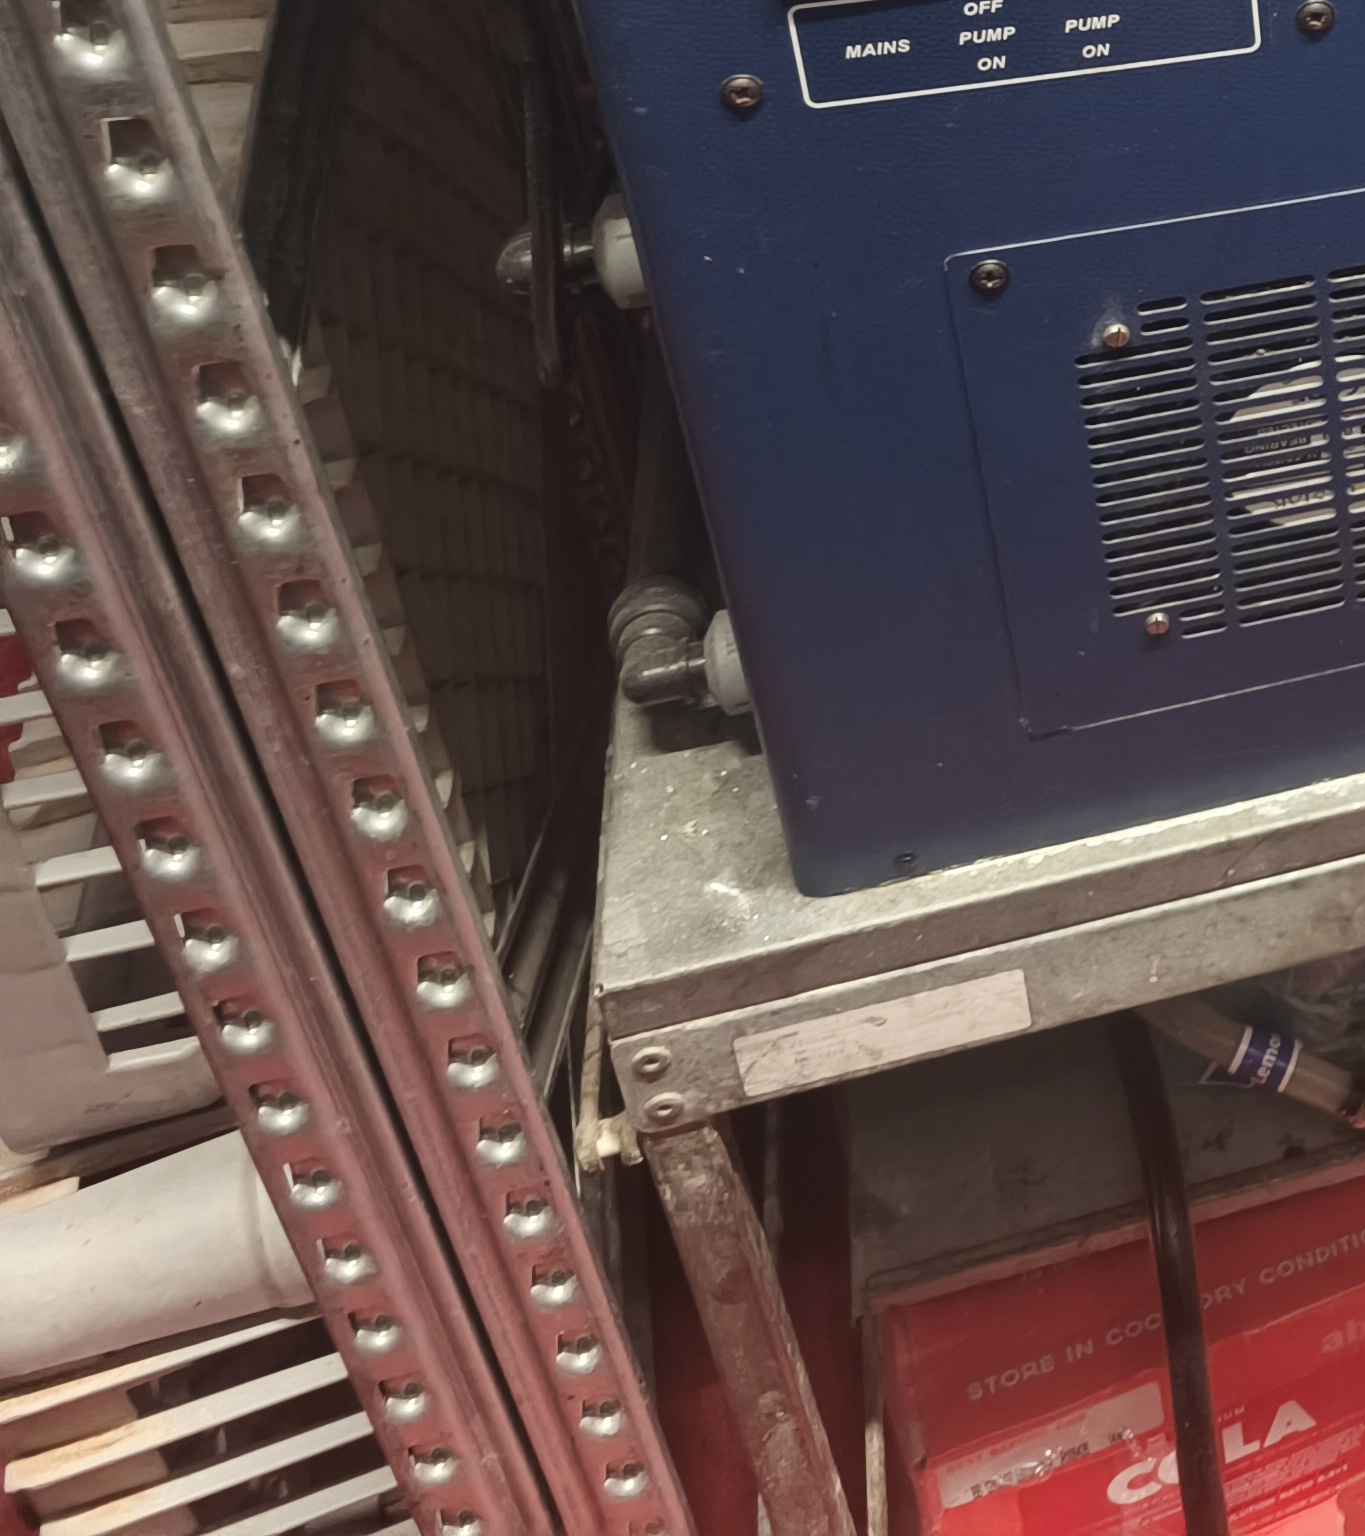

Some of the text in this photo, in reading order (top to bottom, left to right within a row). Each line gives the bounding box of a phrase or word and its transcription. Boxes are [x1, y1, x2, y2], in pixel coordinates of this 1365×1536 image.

[963, 0, 1004, 17] OFF
[1065, 14, 1121, 33] PUMP
[958, 26, 1017, 45] PUMP
[844, 39, 911, 60] MAINS
[1082, 42, 1110, 59] ON
[976, 55, 1007, 71] ON
[967, 1354, 1056, 1401] STORE
[1066, 1339, 1095, 1364] IN
[1105, 1312, 1162, 1346] COO
